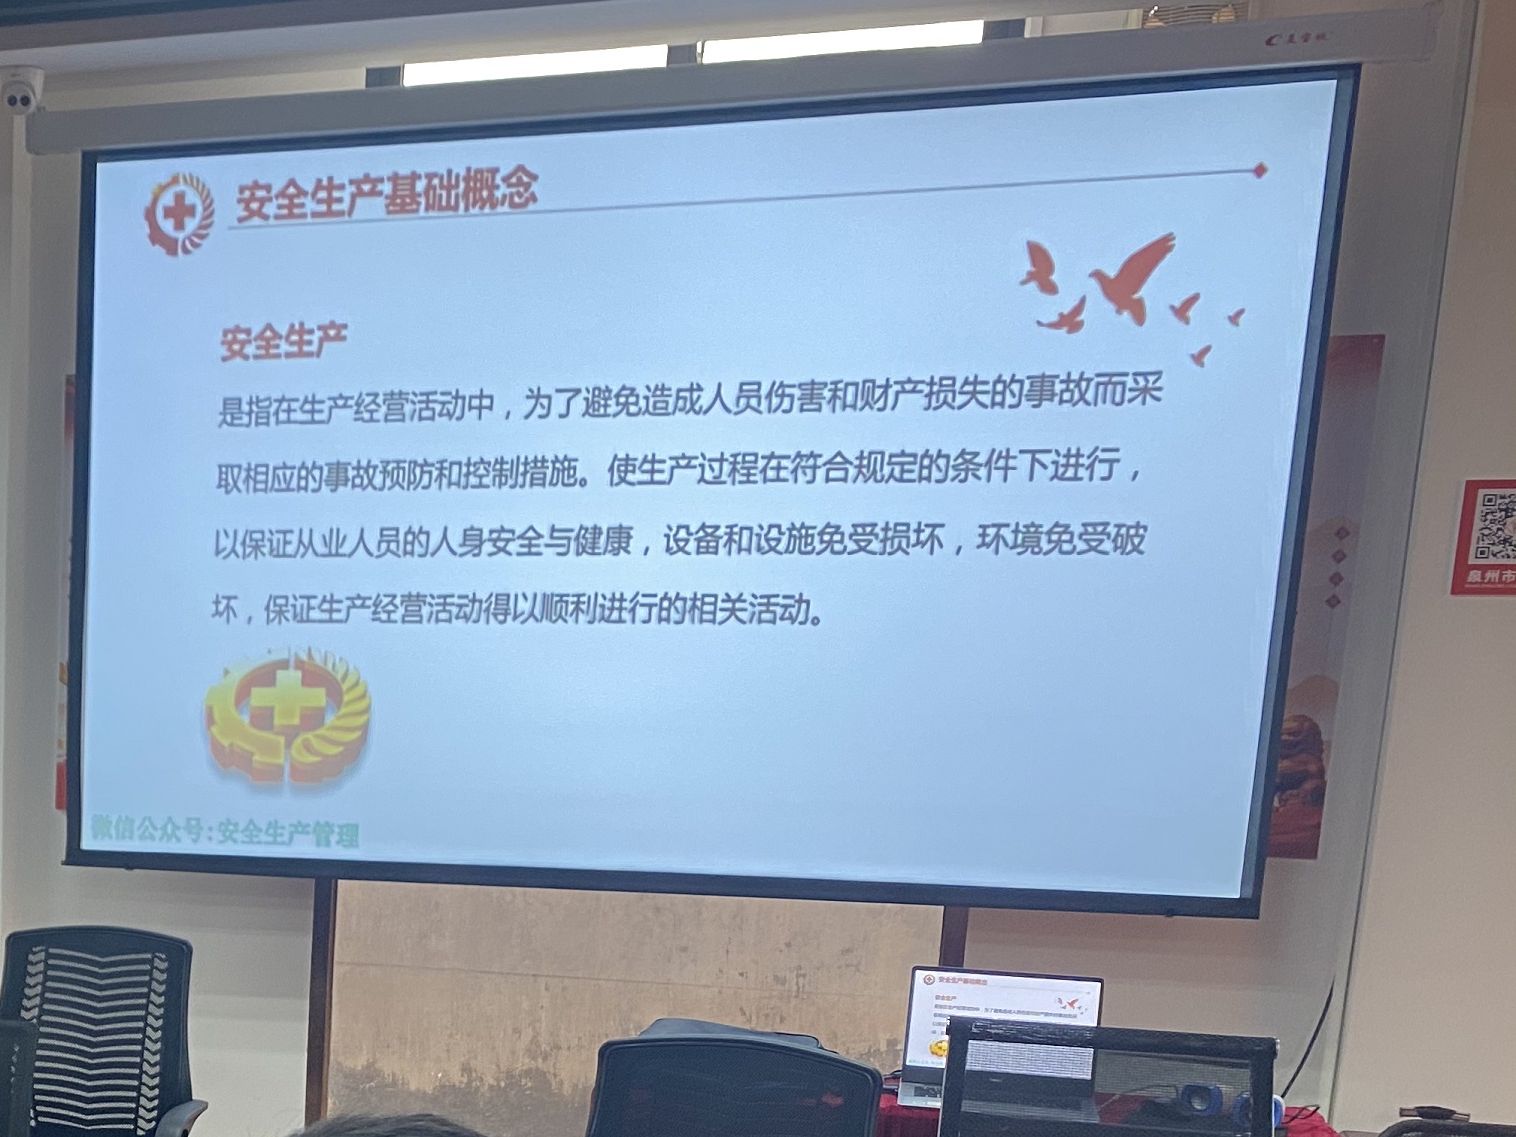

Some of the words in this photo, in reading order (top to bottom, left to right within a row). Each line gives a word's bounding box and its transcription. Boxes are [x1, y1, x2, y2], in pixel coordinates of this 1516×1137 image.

[236, 163, 539, 223] 安全生产基础概念
[221, 320, 348, 362] 安全生产
